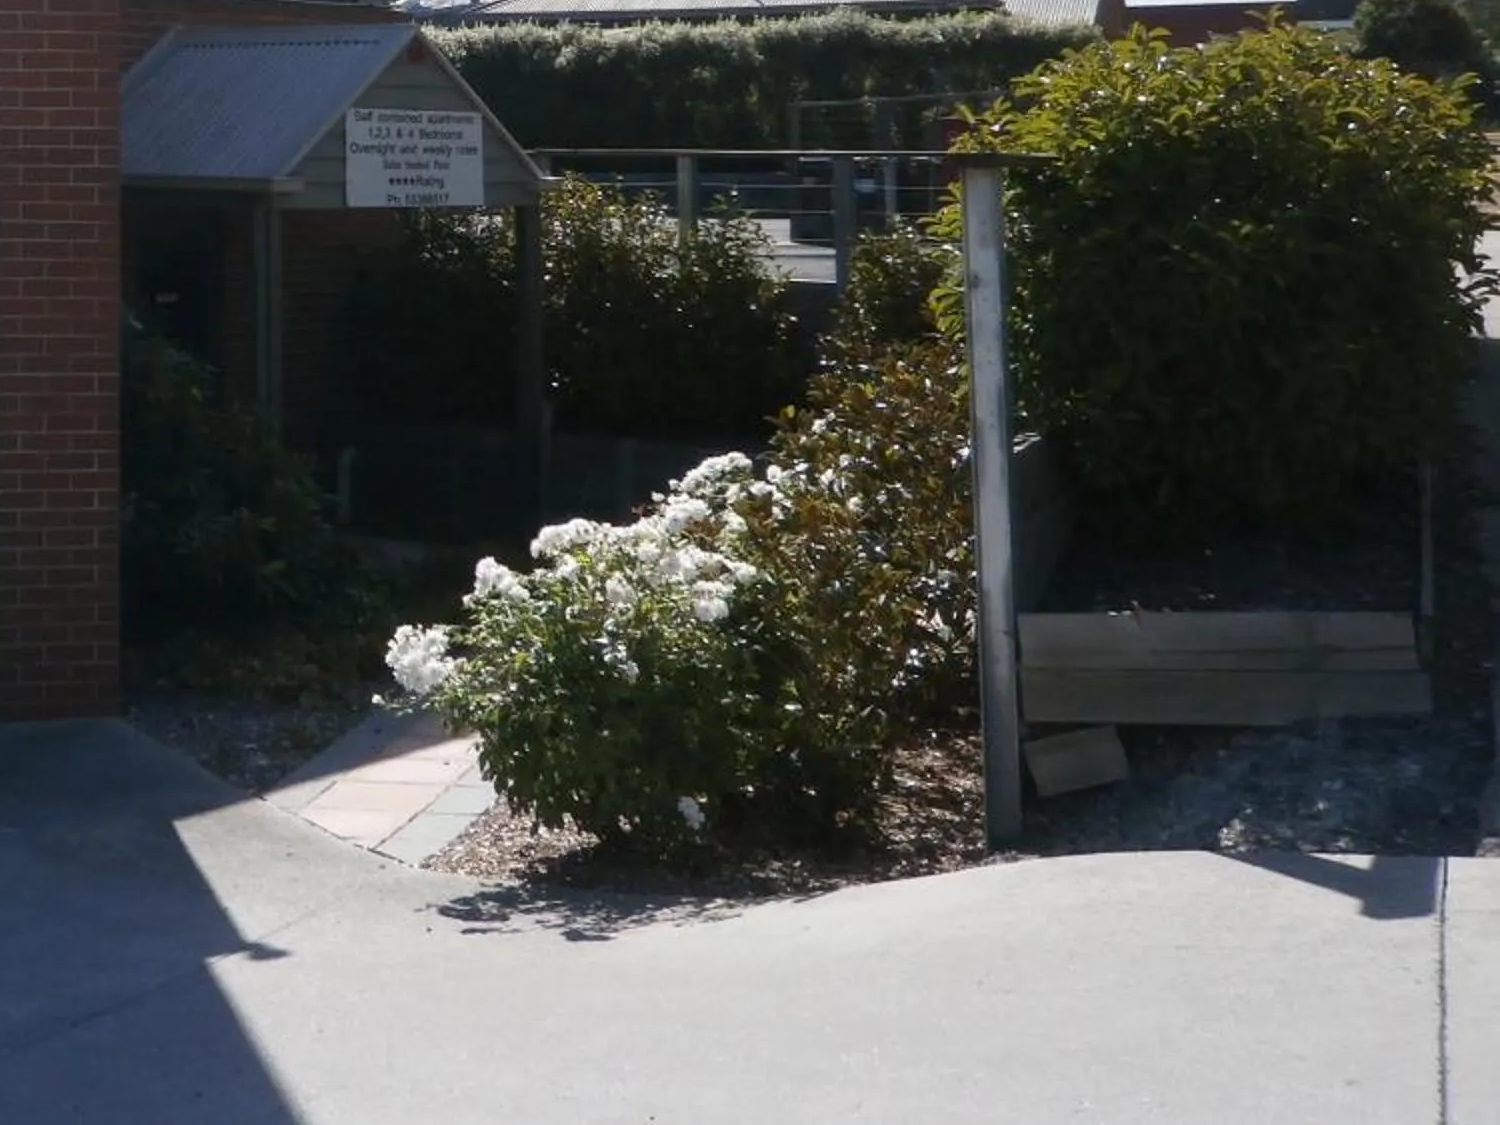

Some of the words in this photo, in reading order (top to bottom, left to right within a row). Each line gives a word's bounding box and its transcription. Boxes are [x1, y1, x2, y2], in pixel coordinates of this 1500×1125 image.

[350, 141, 396, 156] Overnight
[400, 143, 419, 154] and
[423, 144, 453, 157] weekly
